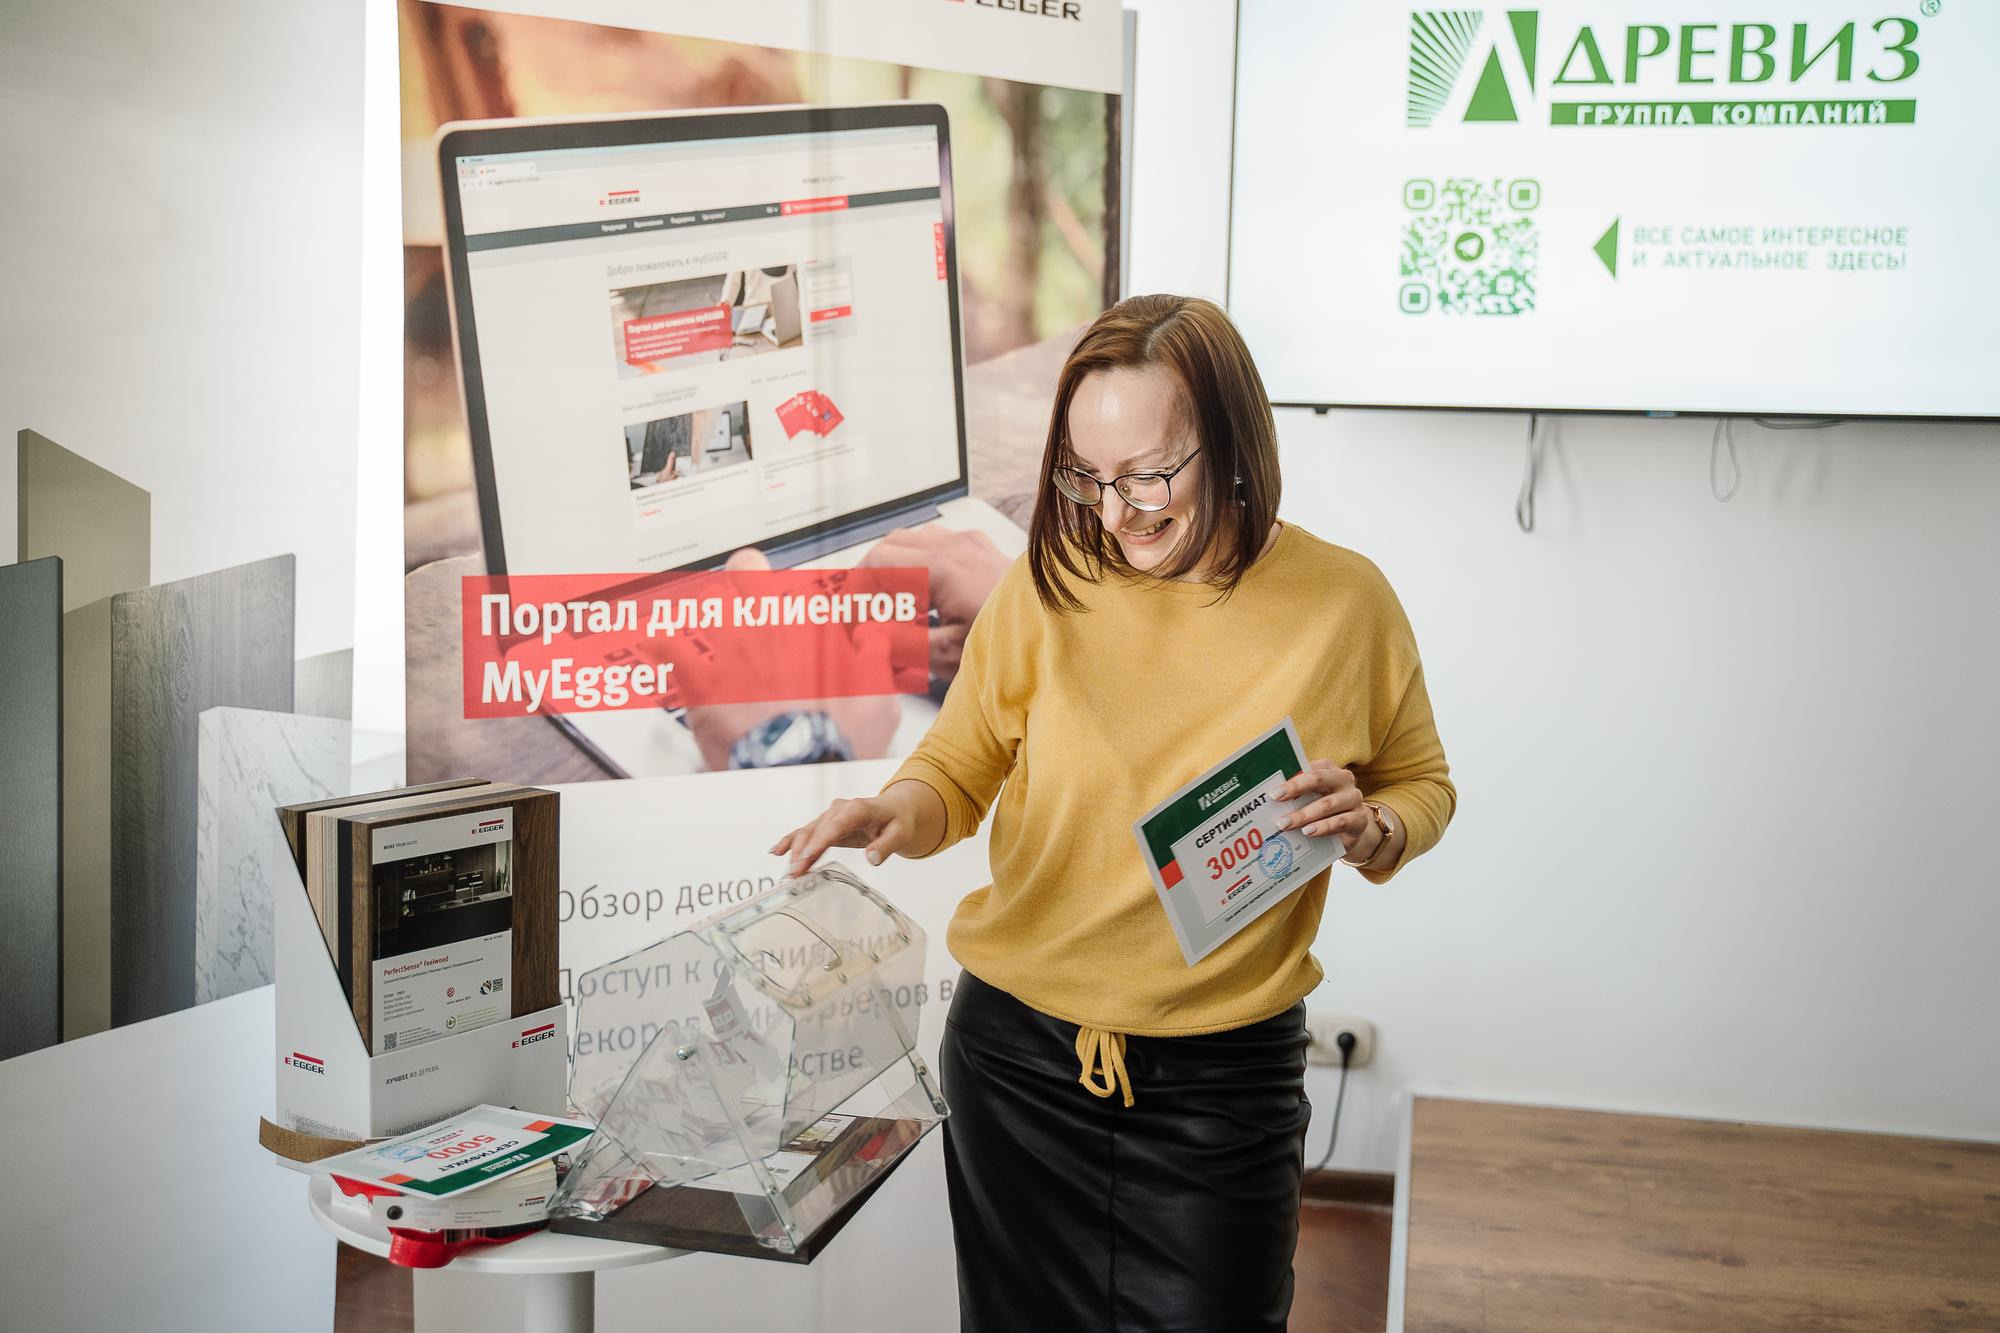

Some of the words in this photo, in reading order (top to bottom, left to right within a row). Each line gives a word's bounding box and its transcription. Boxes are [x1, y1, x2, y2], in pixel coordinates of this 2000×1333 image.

[1576, 104, 1695, 126] ГРУППА
[1712, 99, 1887, 126] КОМПАНИЙ
[1632, 226, 1675, 246] ВСЕ
[1681, 225, 1754, 246] САМОЕ
[1761, 225, 1910, 246] ИНТЕРЕСНОЕ
[1631, 251, 1648, 267] И
[1662, 250, 1809, 270] АКТУАЛЬНОЕ
[1826, 250, 1908, 271] ЗДЕСЬ!
[480, 593, 638, 645] Портал
[646, 597, 723, 638] для
[732, 592, 916, 627] клиентов
[481, 657, 674, 713] MyEgger
[479, 824, 504, 833] EGGER
[1195, 792, 1267, 848] СЕРТИФИКАТ
[1206, 827, 1263, 880] 3000
[423, 955, 449, 968] Feelwood
[521, 1029, 555, 1046] EGGER
[293, 1059, 325, 1075] EGGER
[385, 1073, 408, 1085] ЛУЧШЕЕ
[284, 1109, 338, 1135] Лакированные
[426, 1135, 497, 1159] 5000
[439, 1140, 519, 1171] СЕРТИФИКАТ
